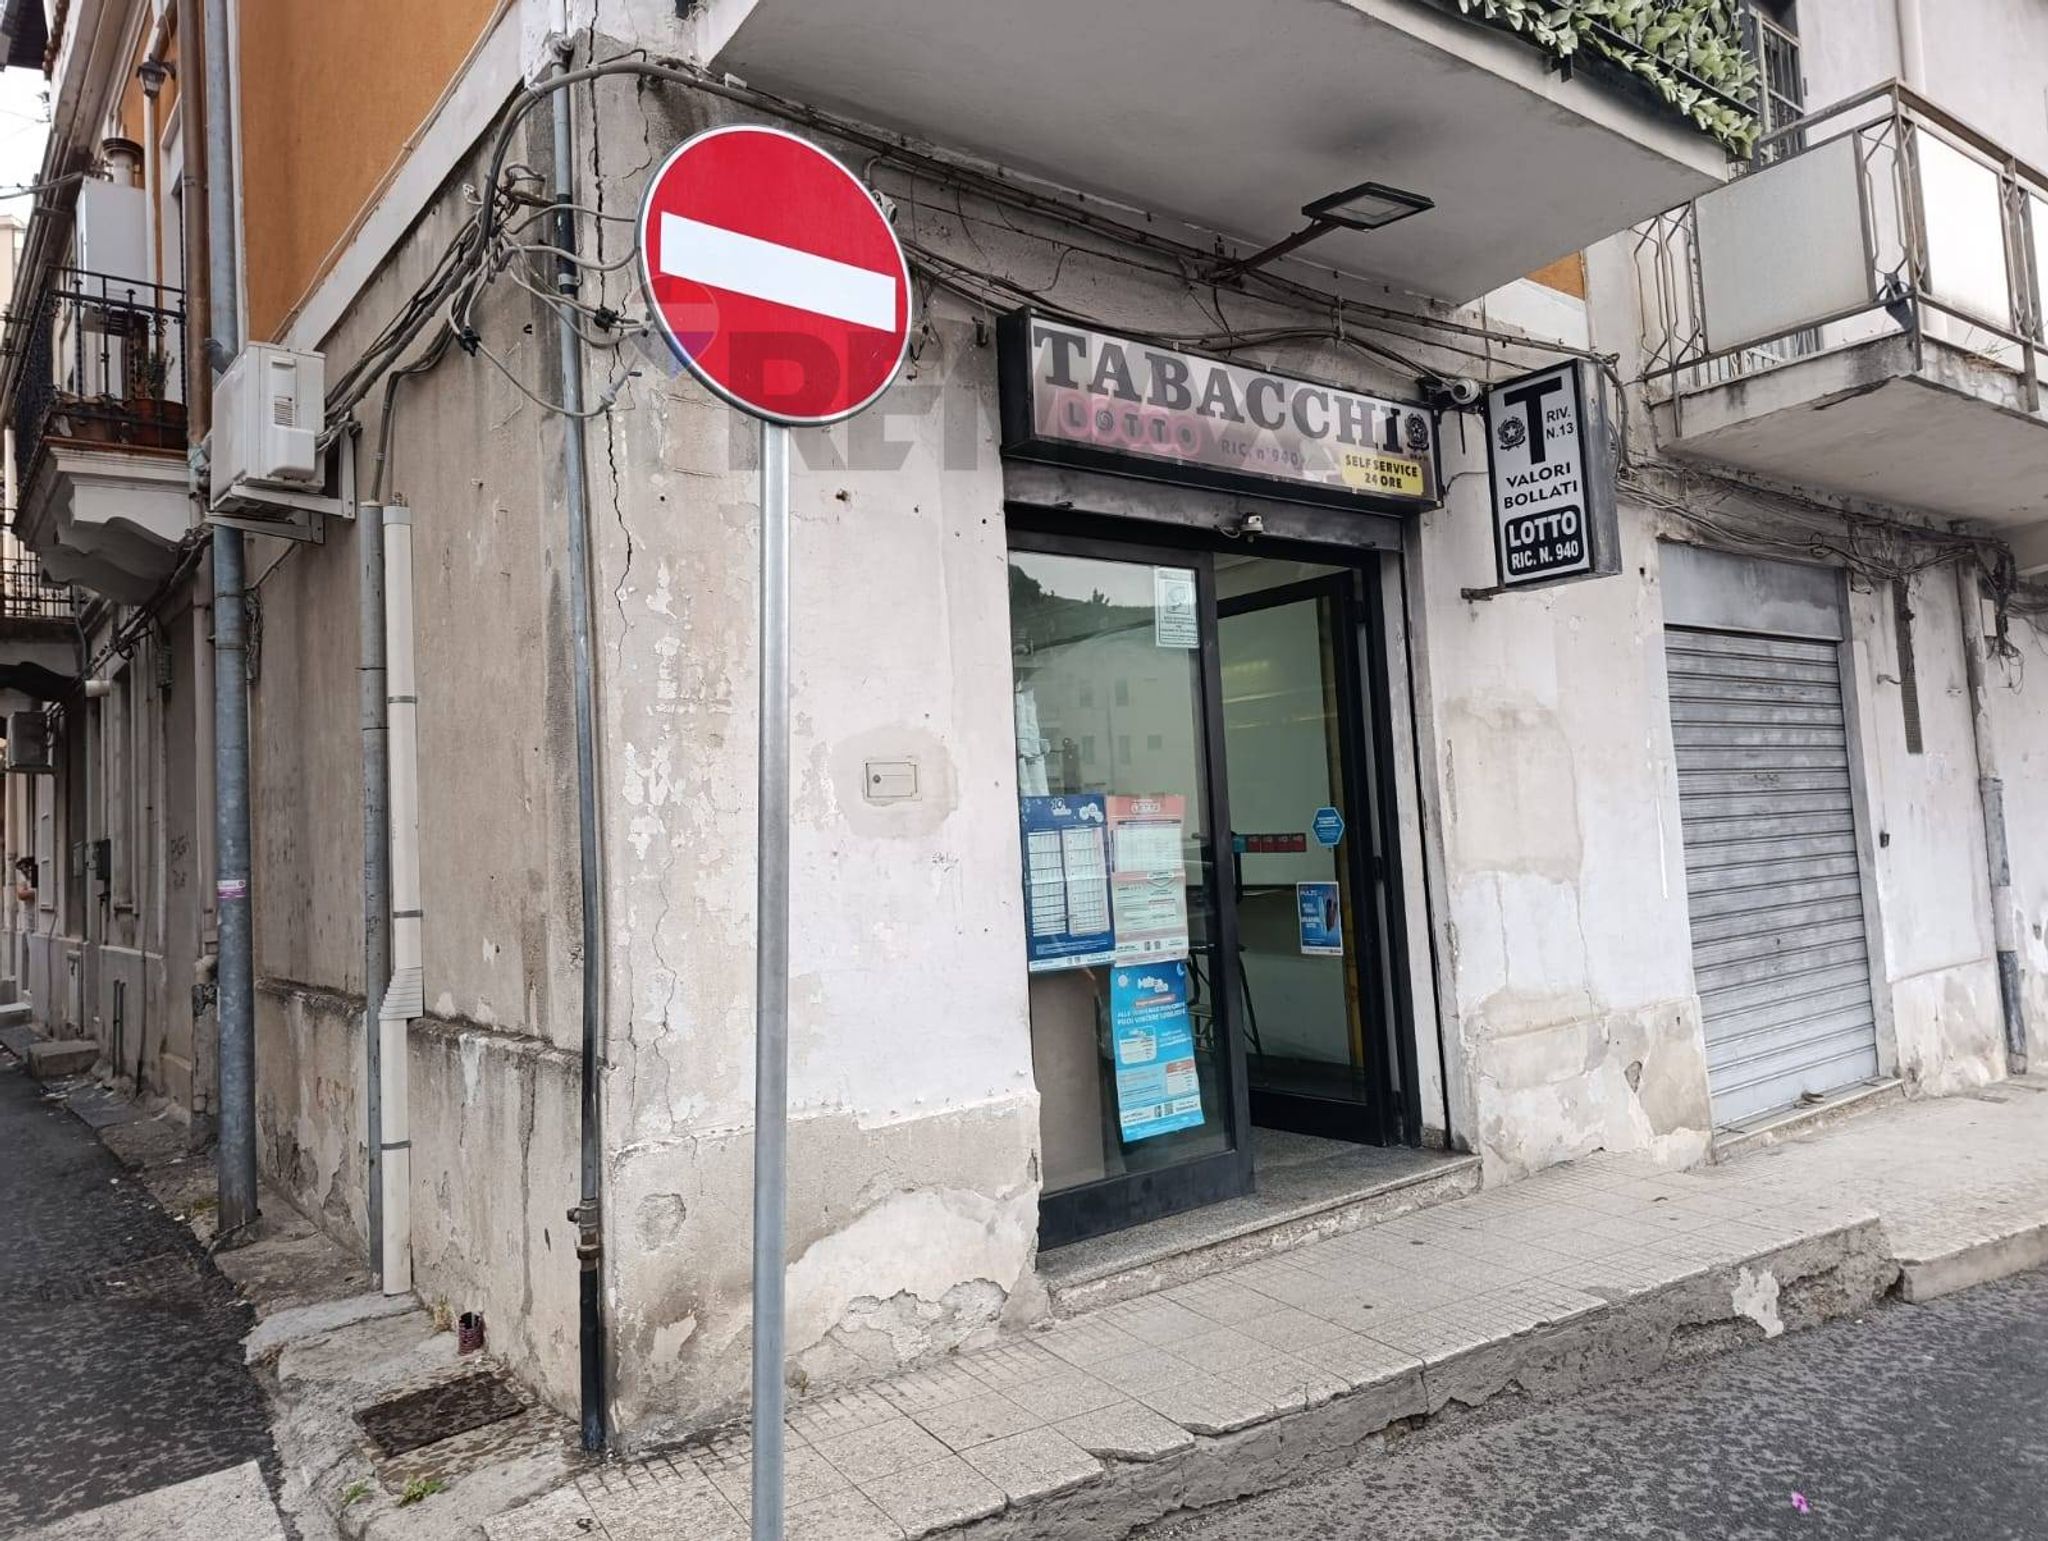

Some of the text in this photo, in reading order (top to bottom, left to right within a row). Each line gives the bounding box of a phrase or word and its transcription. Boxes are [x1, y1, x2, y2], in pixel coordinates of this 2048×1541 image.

[1034, 326, 1403, 453] TABACCHI
[1504, 376, 1562, 465] T
[1546, 406, 1571, 423] RIV.
[1546, 423, 1574, 440] N.13
[1346, 454, 1418, 477] SELF SERVICE
[1506, 462, 1571, 488] VALORI
[1365, 472, 1403, 489] 24 ORE
[1504, 480, 1578, 509] BOLLATI
[1508, 510, 1577, 547] LOTTO
[1511, 541, 1579, 569] RIC. N. 940
